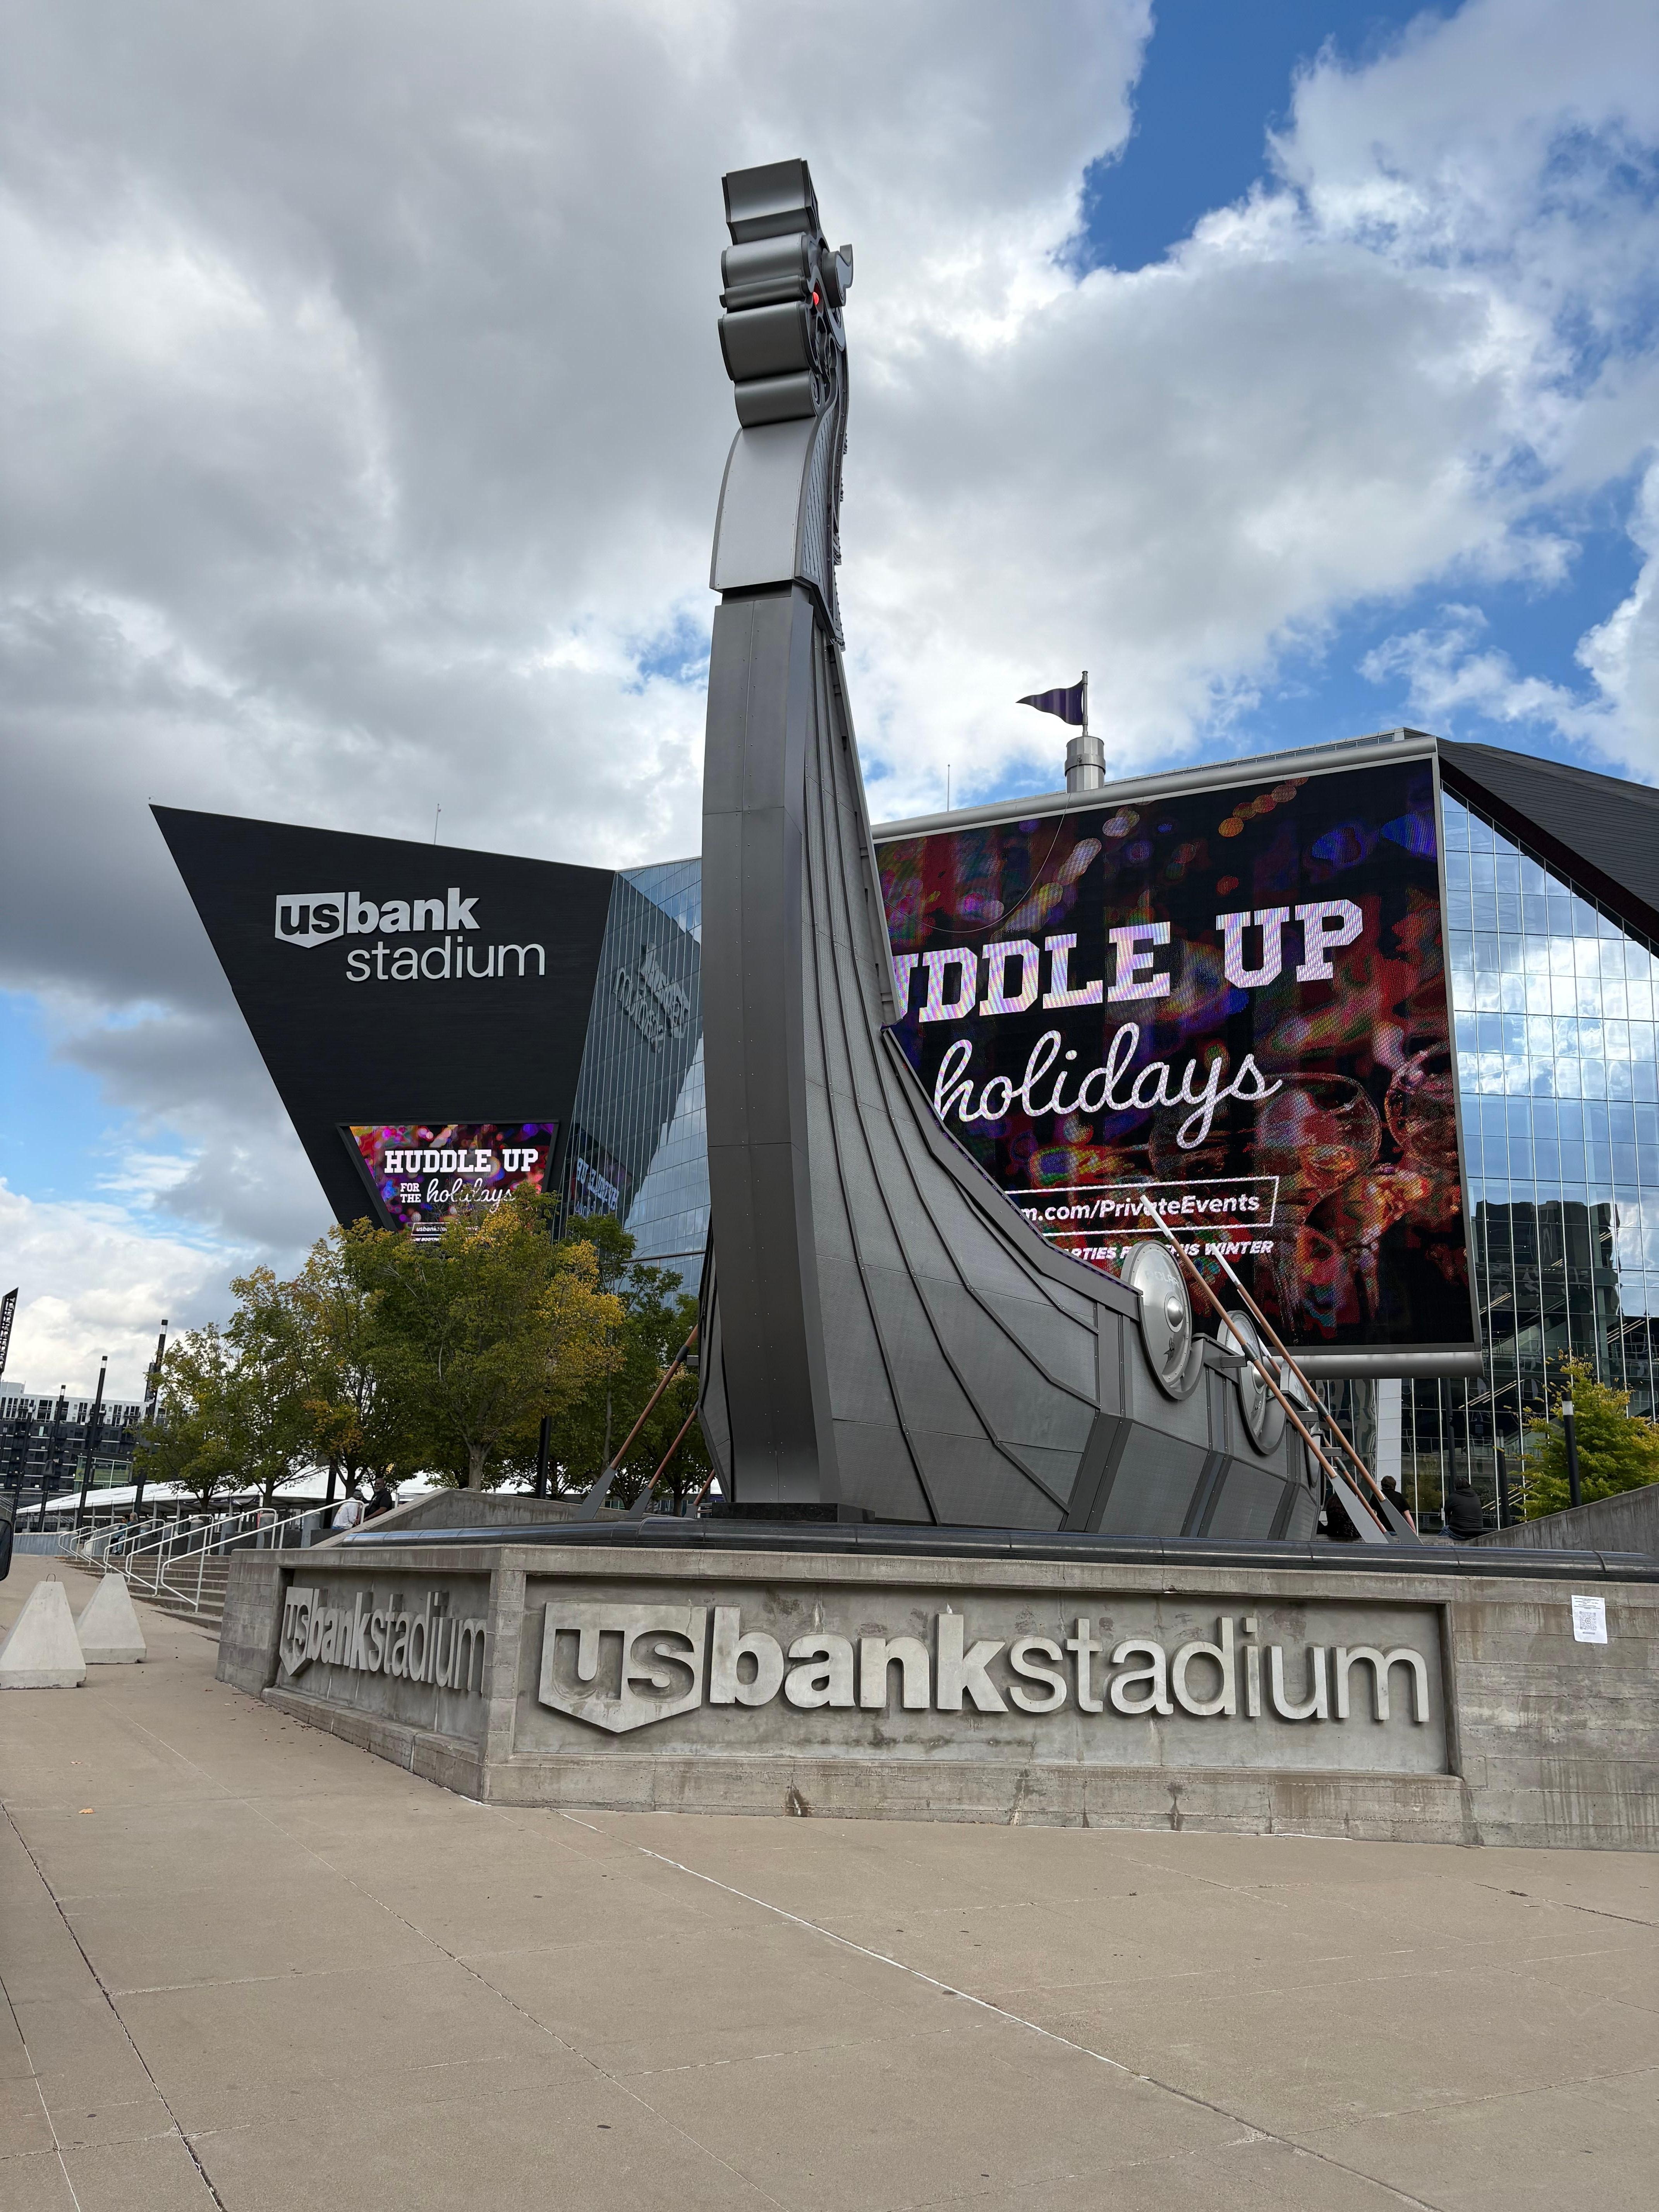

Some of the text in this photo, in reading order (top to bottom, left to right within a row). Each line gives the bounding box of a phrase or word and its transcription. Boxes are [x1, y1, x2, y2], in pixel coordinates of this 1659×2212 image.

[1216, 898, 1363, 989] UP
[346, 936, 545, 981] stadium
[933, 1022, 1283, 1149] holidays
[384, 1149, 538, 1173] HUDDLE UP
[400, 1183, 420, 1192] FOR
[400, 1194, 421, 1203] THE
[1064, 1247, 1117, 1260] RTIES
[1205, 1240, 1274, 1255] WINTER
